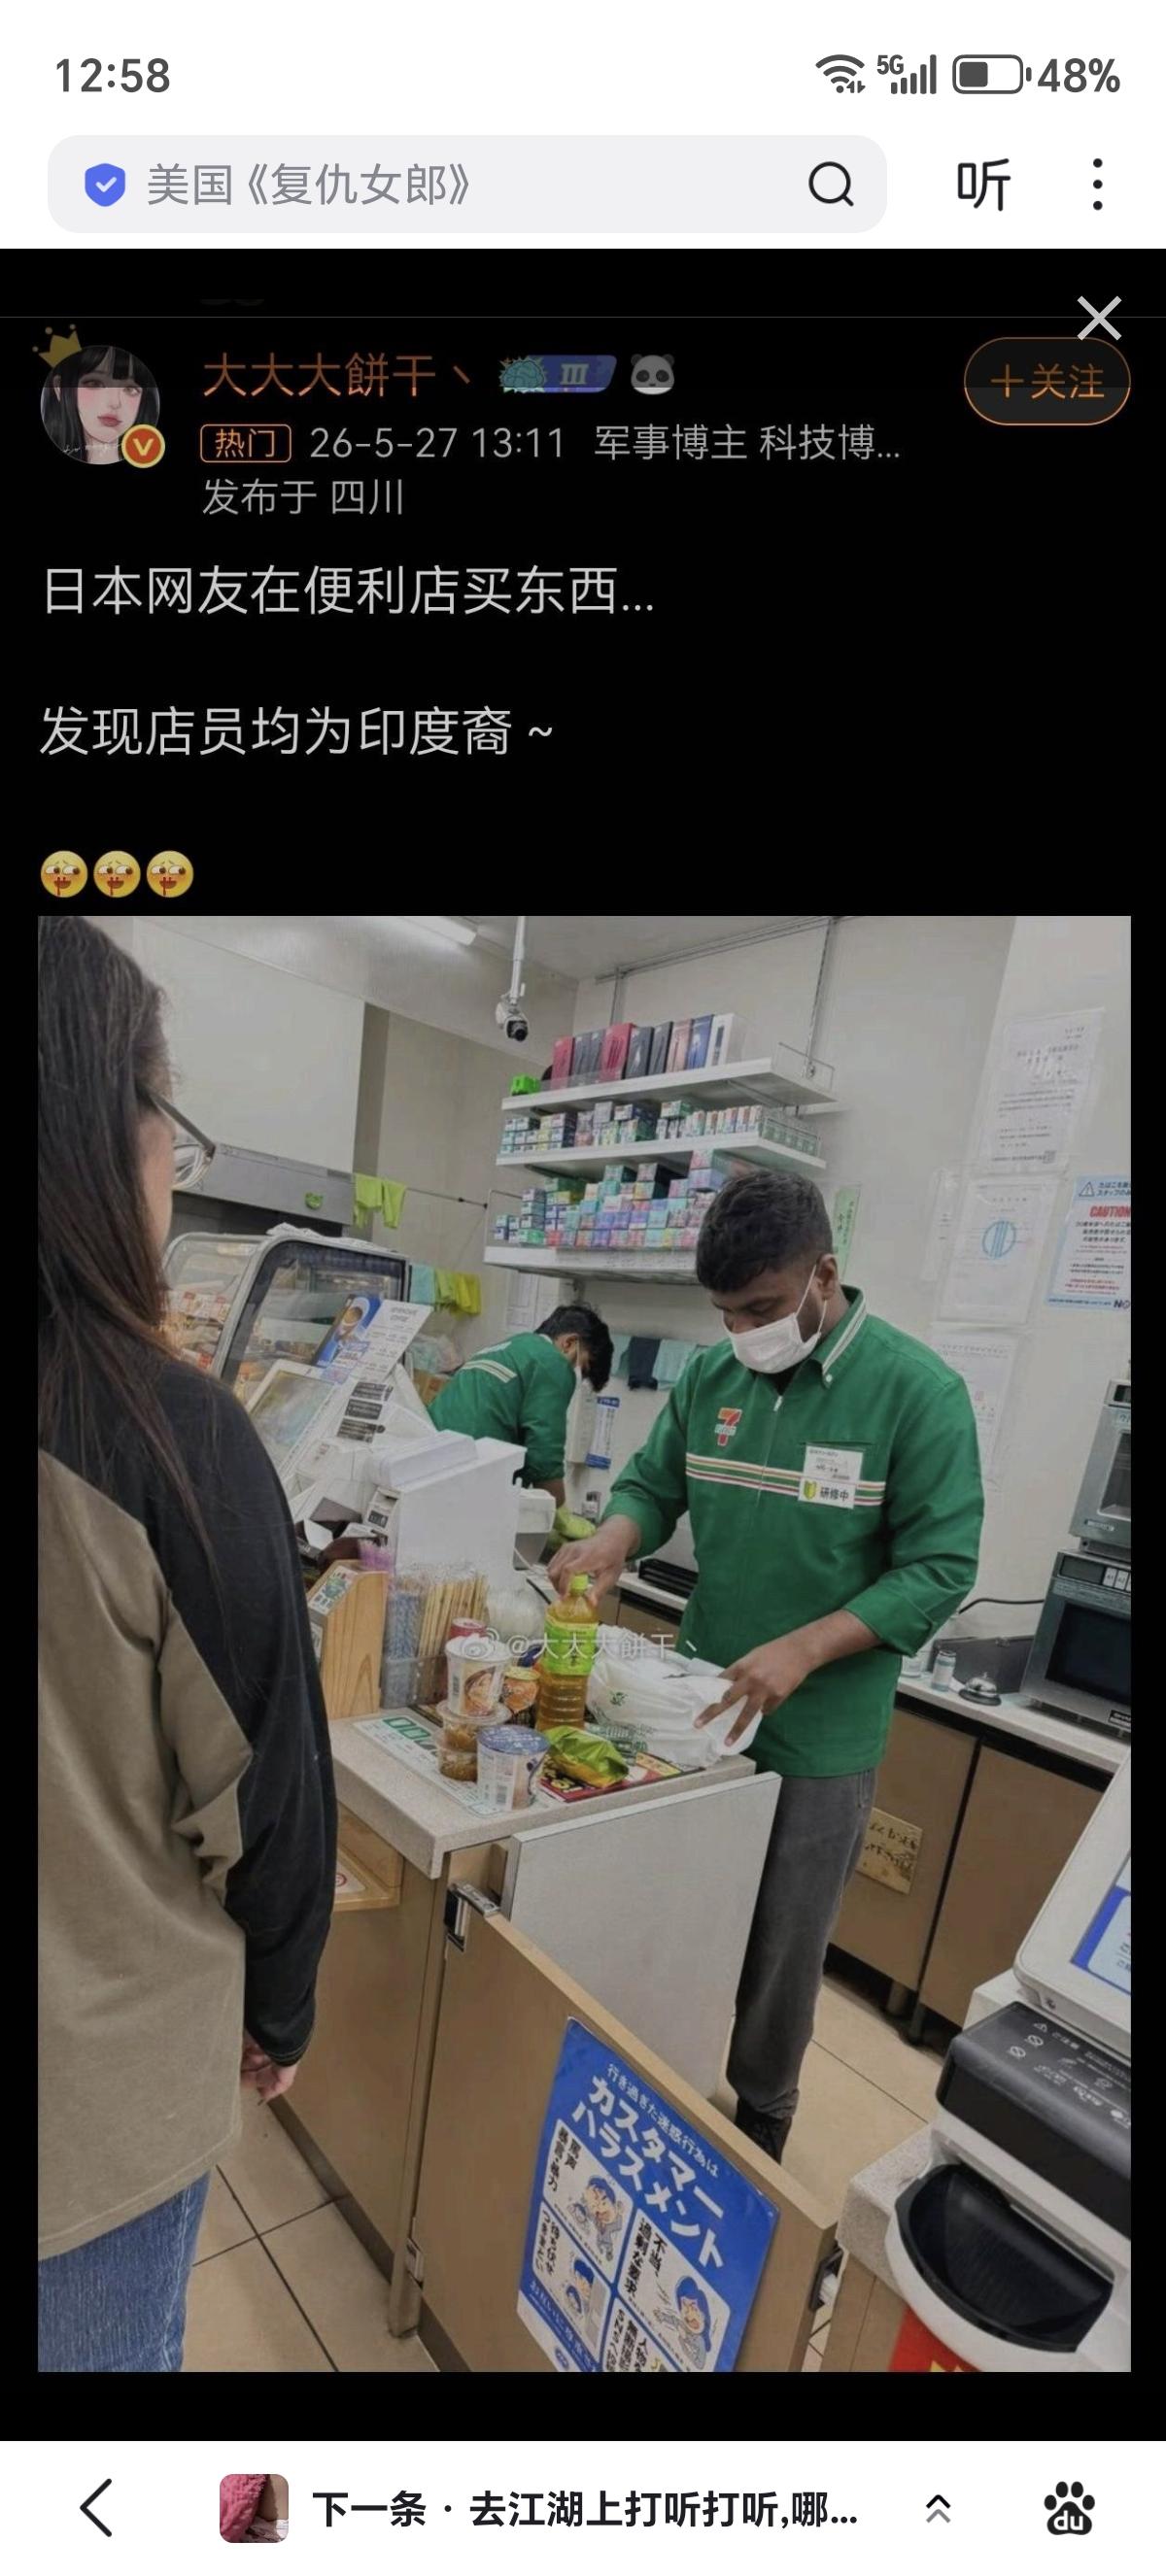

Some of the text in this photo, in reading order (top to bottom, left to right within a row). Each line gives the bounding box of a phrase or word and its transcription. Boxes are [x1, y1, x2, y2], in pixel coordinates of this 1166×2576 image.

[55, 58, 171, 92] 12:58
[876, 54, 905, 75] 5G
[1038, 58, 1121, 93] 48%
[147, 162, 469, 206] 美国《复仇女郎》
[956, 157, 1012, 213] 听
[215, 427, 275, 458] 热门
[310, 427, 564, 458] 26-5-27 13:11
[594, 424, 900, 461] 军事博主 科技博...
[202, 477, 403, 516] 发布于 四川
[46, 563, 654, 616] 日本网友在便利店买东西...
[607, 2063, 719, 2179] 行き過ぎた迷惑行為は
[588, 2075, 725, 2220] カスタマー
[571, 2100, 725, 2269] ハラスメント
[312, 2490, 428, 2529] 下一条
[1053, 2509, 1084, 2531] du
